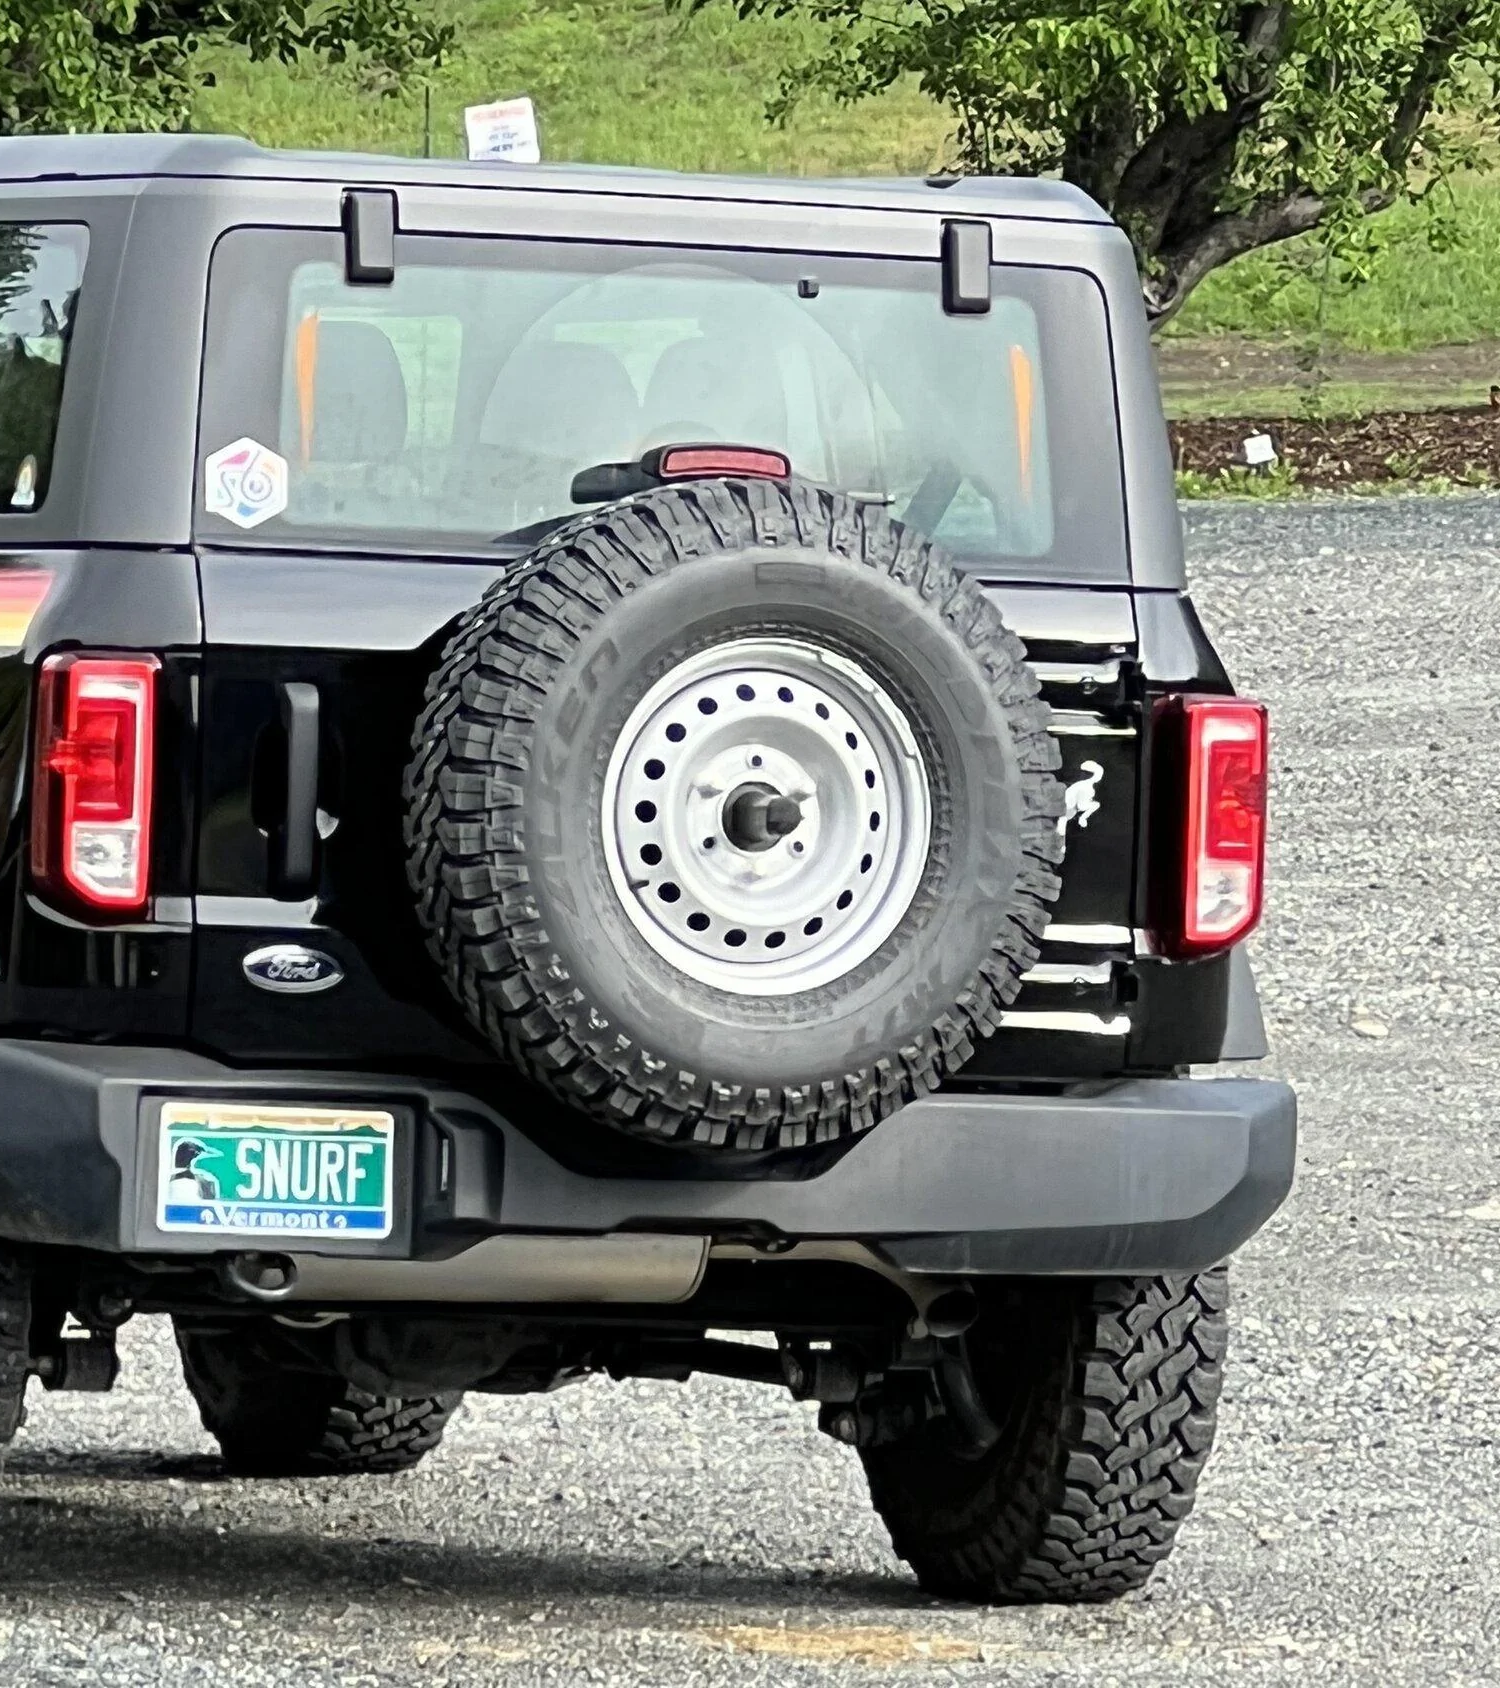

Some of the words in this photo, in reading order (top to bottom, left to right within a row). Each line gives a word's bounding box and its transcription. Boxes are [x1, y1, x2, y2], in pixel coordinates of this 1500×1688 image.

[267, 954, 320, 980] Ford
[235, 1138, 374, 1203] SNURF
[213, 1204, 331, 1230] Vermont
